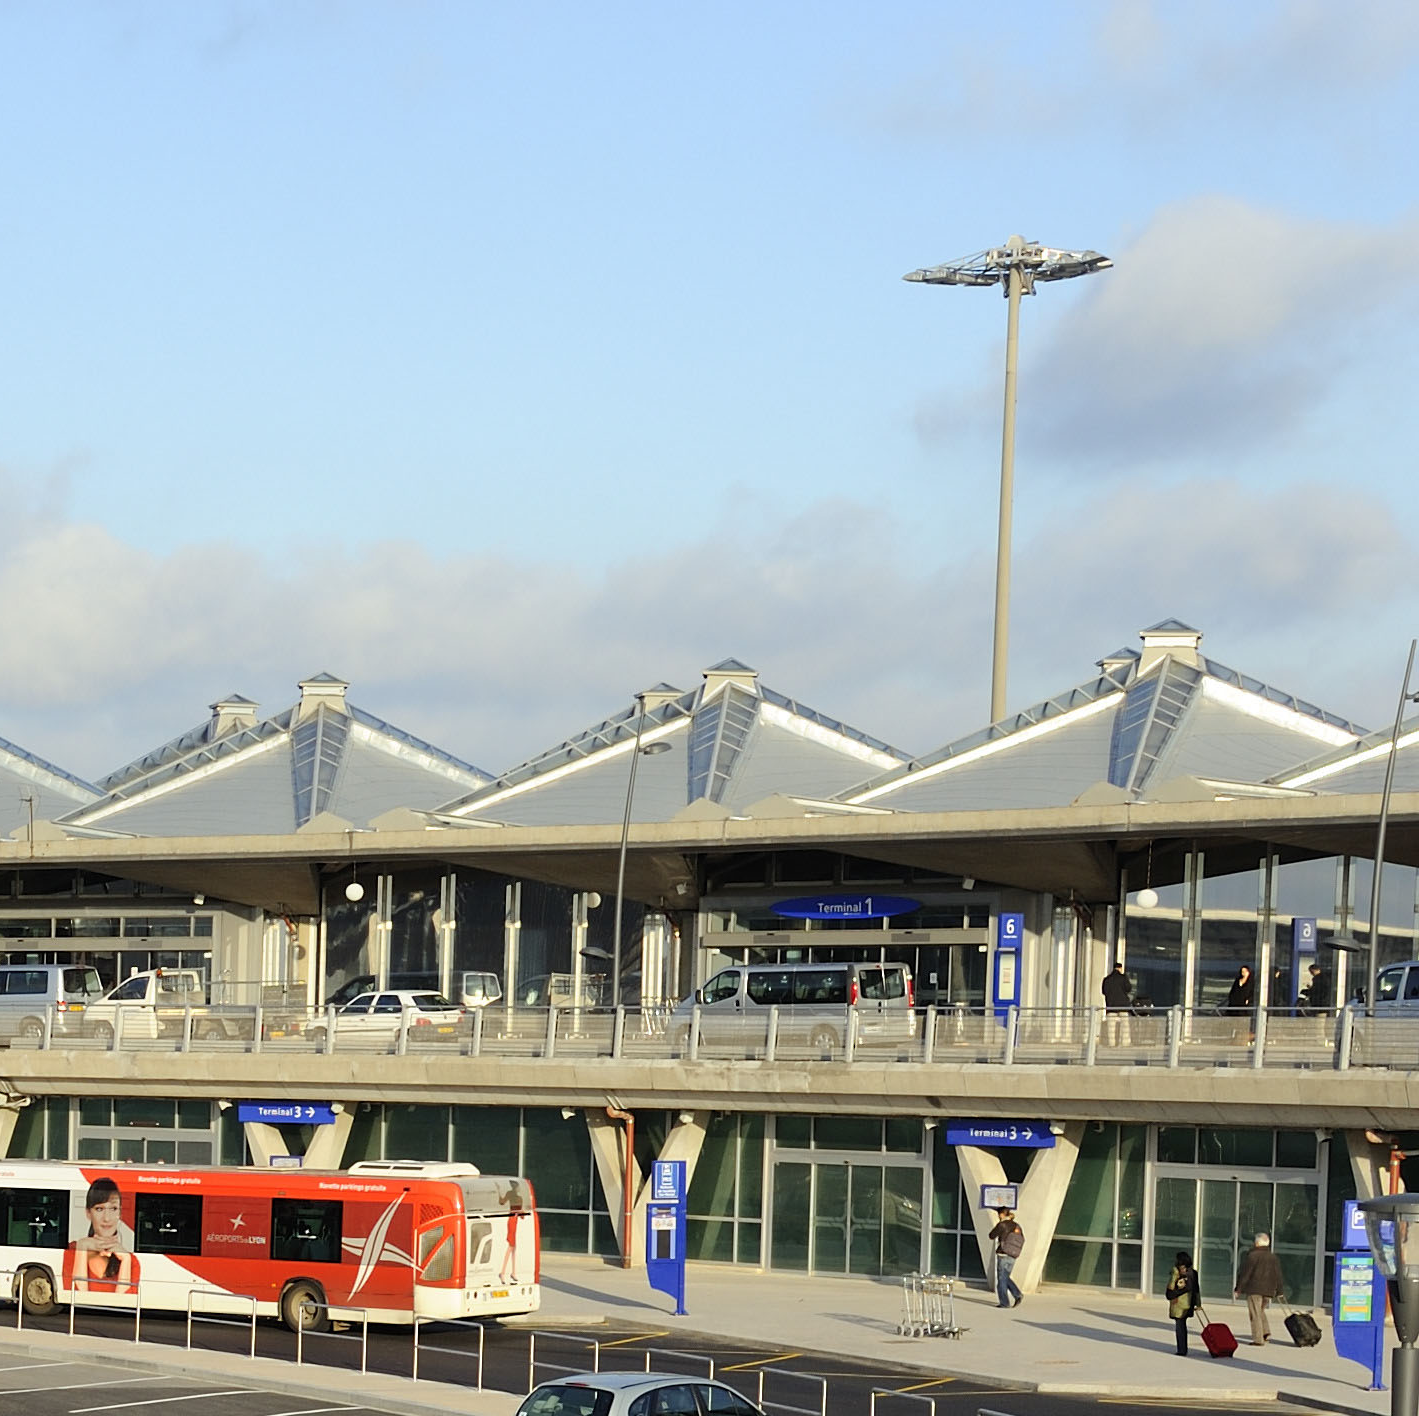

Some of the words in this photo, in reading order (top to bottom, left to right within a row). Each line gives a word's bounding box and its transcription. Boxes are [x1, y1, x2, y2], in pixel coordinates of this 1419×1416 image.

[818, 901, 861, 913] Terminal
[865, 897, 872, 915] 1
[1006, 918, 1014, 934] 6
[258, 1106, 293, 1116] Terminal
[294, 1105, 302, 1119] 3
[969, 1127, 1008, 1138] Terminal
[1009, 1126, 1017, 1140] 3
[249, 1236, 266, 1245] LYON
